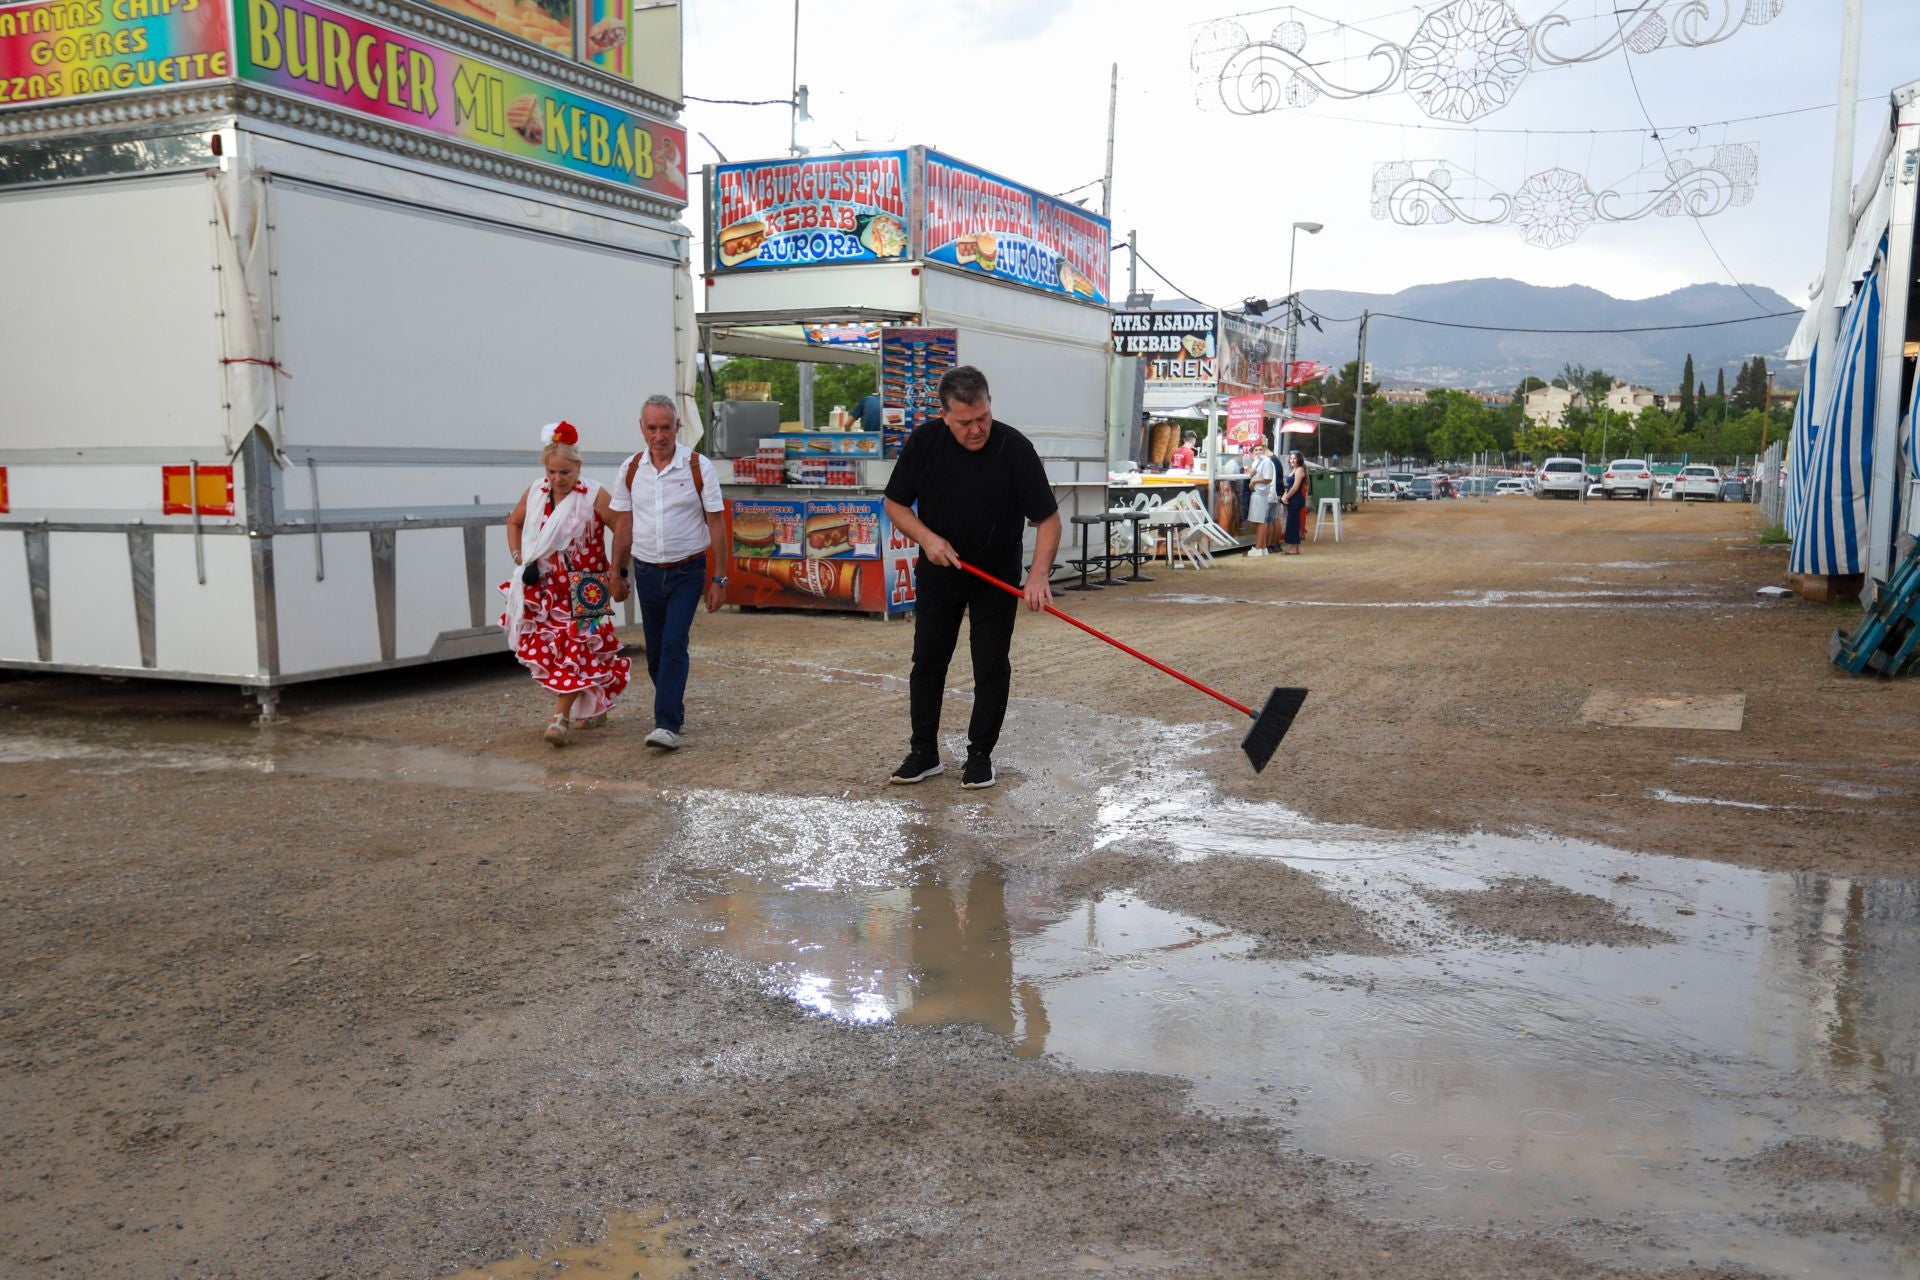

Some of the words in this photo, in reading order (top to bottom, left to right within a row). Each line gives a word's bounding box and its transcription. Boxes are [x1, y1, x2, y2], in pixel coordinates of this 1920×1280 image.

[30, 26, 148, 66] GOFRES
[71, 51, 227, 94] BAGUETTE
[246, 0, 440, 119] BURGER
[453, 64, 504, 137] MI
[544, 96, 655, 181] KEBAB
[719, 158, 905, 229] HAMBURGUESERIA
[927, 162, 1033, 253] HAMBURGUESERIA
[765, 205, 857, 236] KEBAB
[758, 233, 864, 261] AURORA
[996, 240, 1059, 286] AURORA
[1153, 314, 1214, 331] ASADAS
[1114, 336, 1125, 352] Y
[1127, 336, 1182, 352] KEBAB
[1151, 358, 1214, 378] TREN
